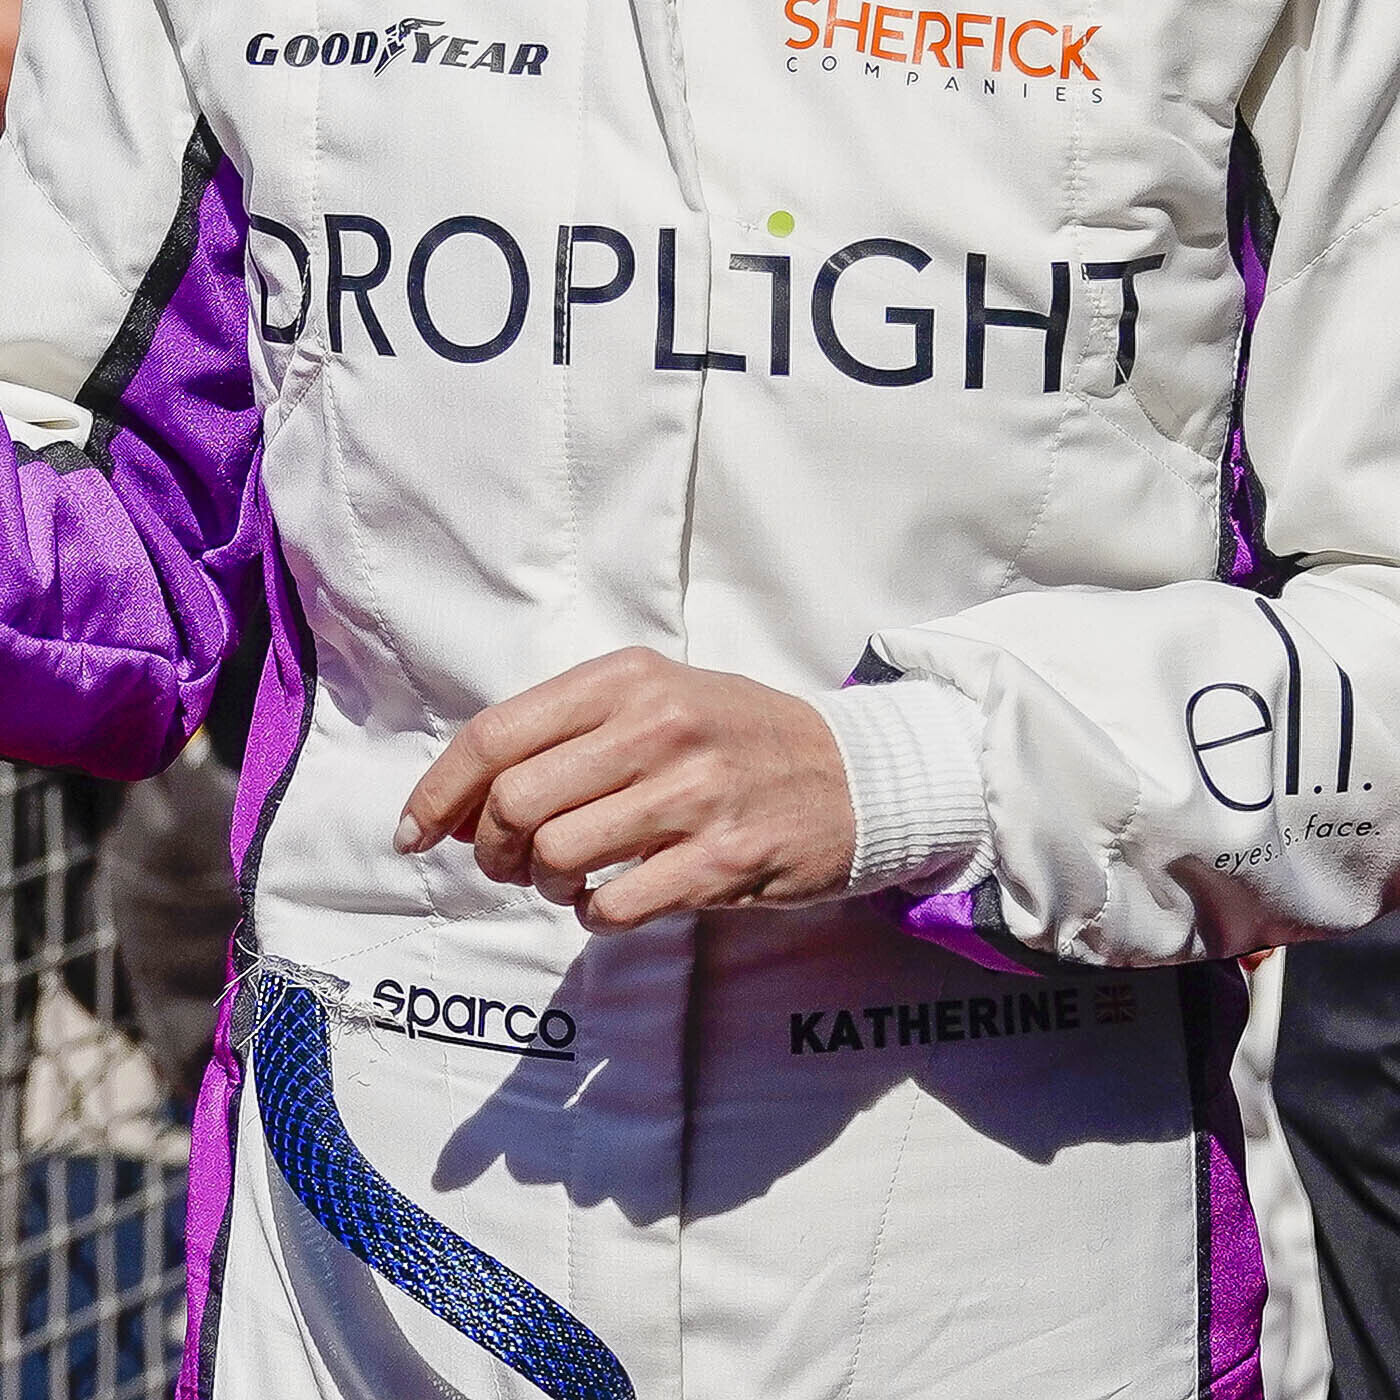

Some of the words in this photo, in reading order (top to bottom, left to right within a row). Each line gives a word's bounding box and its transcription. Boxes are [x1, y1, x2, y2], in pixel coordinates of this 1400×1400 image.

[786, 55, 1102, 104] COMPANIES
[1214, 843, 1279, 875] eyes.
[1304, 813, 1381, 840] face.
[373, 979, 577, 1049] sparco
[789, 988, 1080, 1055] KATHERINE
